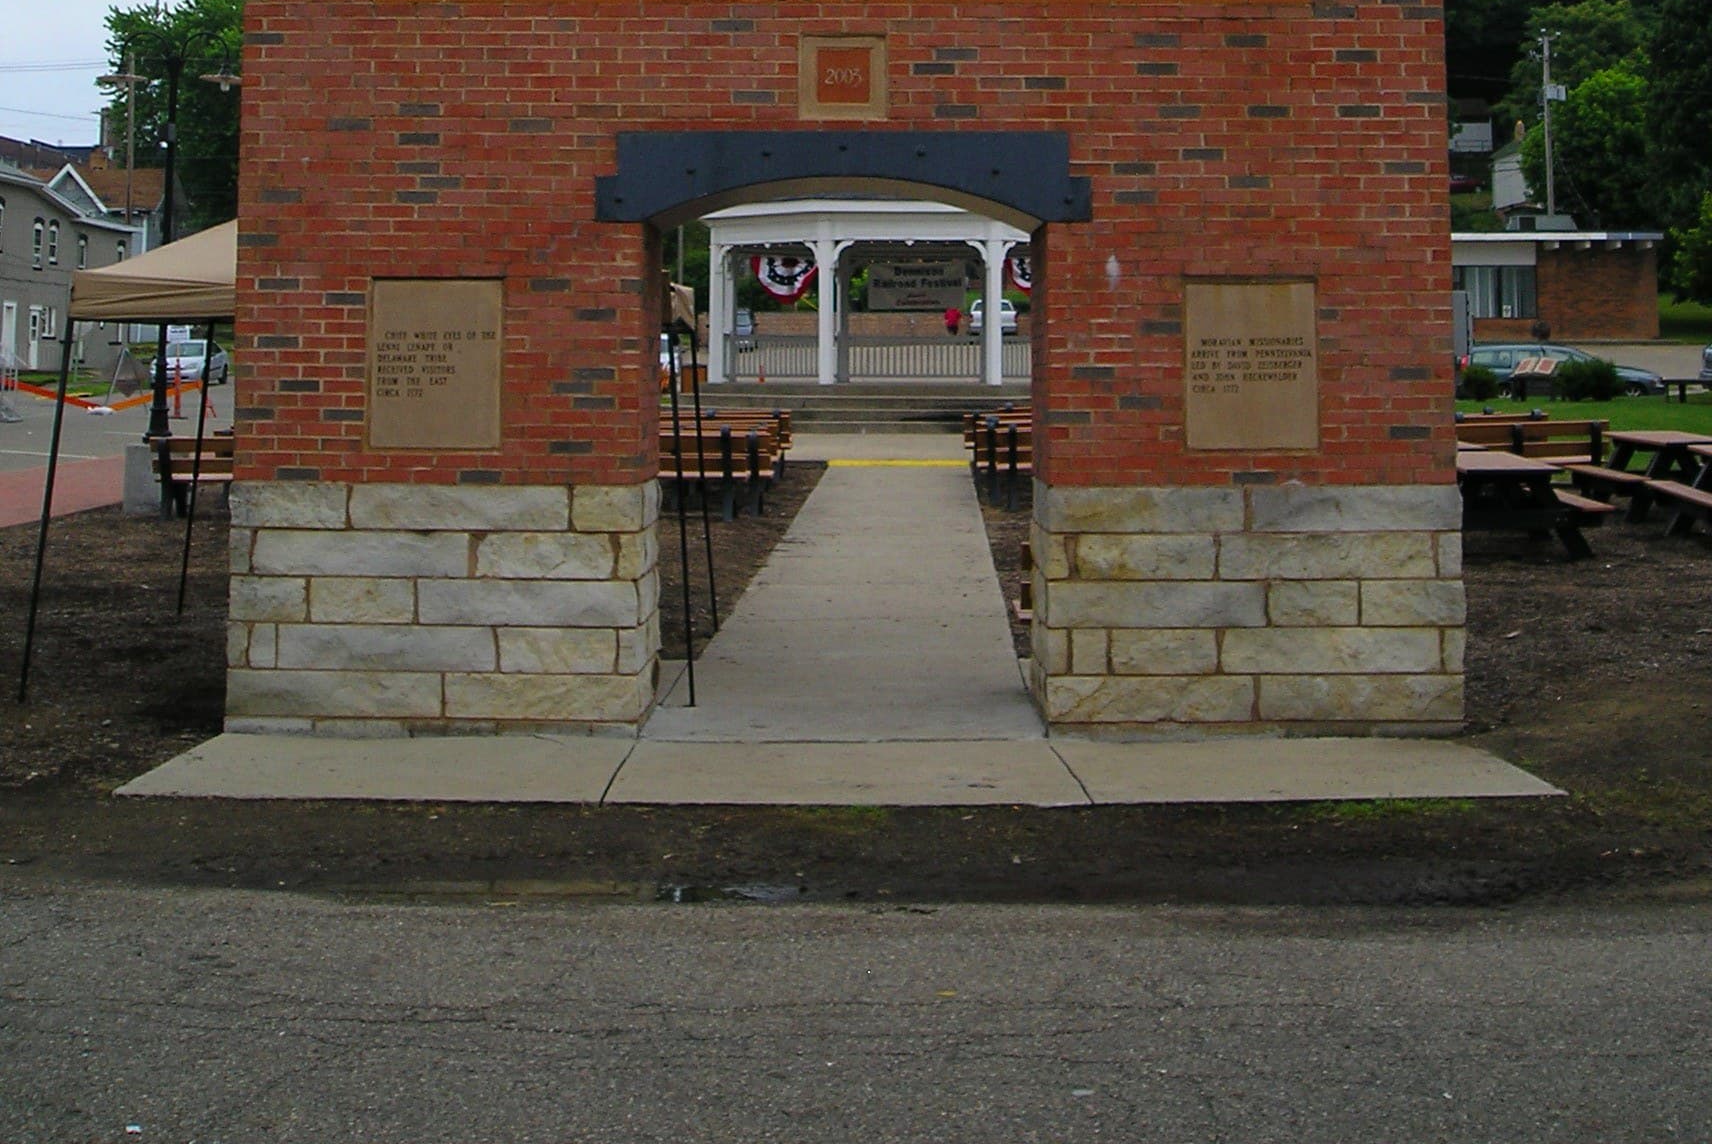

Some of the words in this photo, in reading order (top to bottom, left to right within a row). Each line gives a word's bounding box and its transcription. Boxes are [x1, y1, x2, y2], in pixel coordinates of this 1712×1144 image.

[481, 331, 496, 340] THE
[377, 354, 417, 363] DELAWARE
[1227, 350, 1248, 358] FROM
[429, 377, 448, 386] EAST
